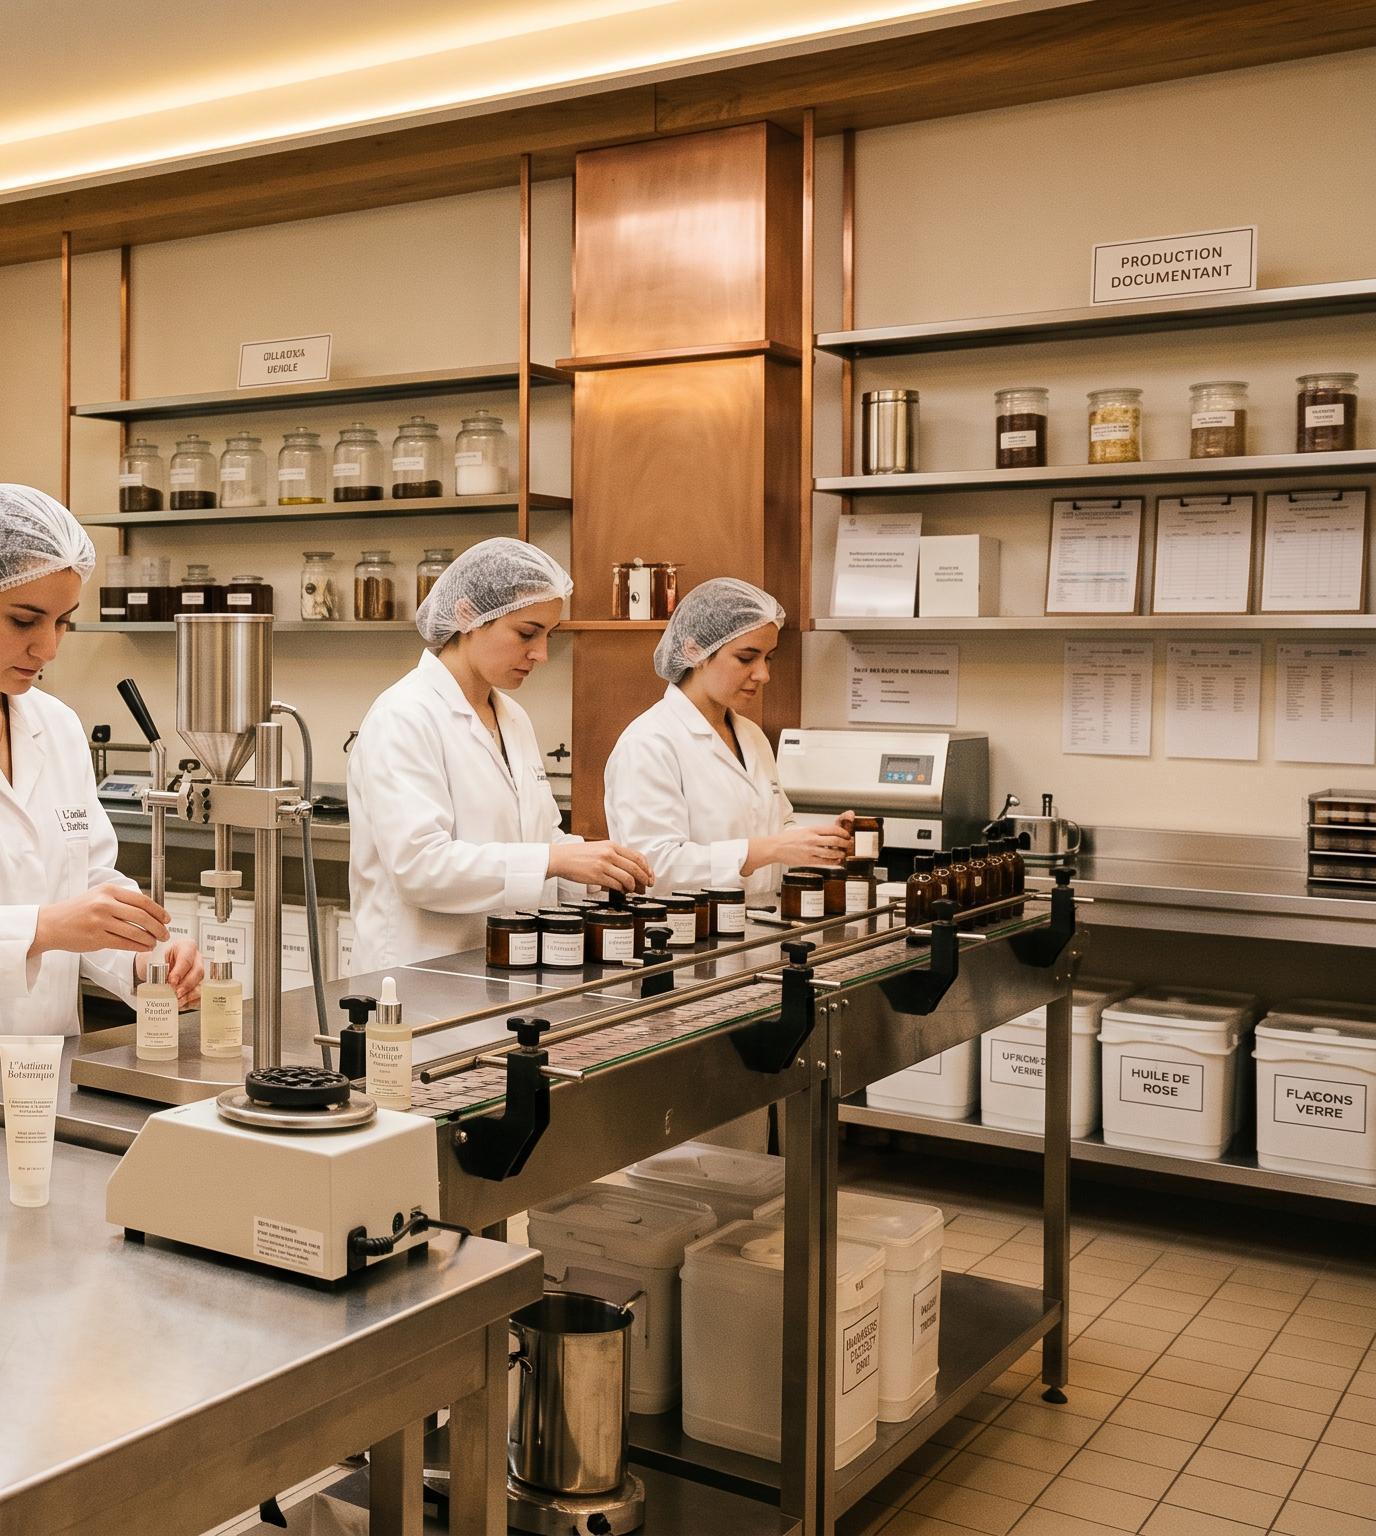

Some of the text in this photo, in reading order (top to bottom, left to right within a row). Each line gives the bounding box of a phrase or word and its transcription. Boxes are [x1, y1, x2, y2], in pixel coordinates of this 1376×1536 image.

[1121, 246, 1222, 268] PRODUCTION
[1111, 264, 1232, 288] DOCUMENTANT
[1131, 1068, 1191, 1085] HUILE DE
[1143, 1083, 1178, 1097] ROSE
[1286, 1088, 1353, 1106] FLACONS
[1296, 1103, 1343, 1119] VERRE
